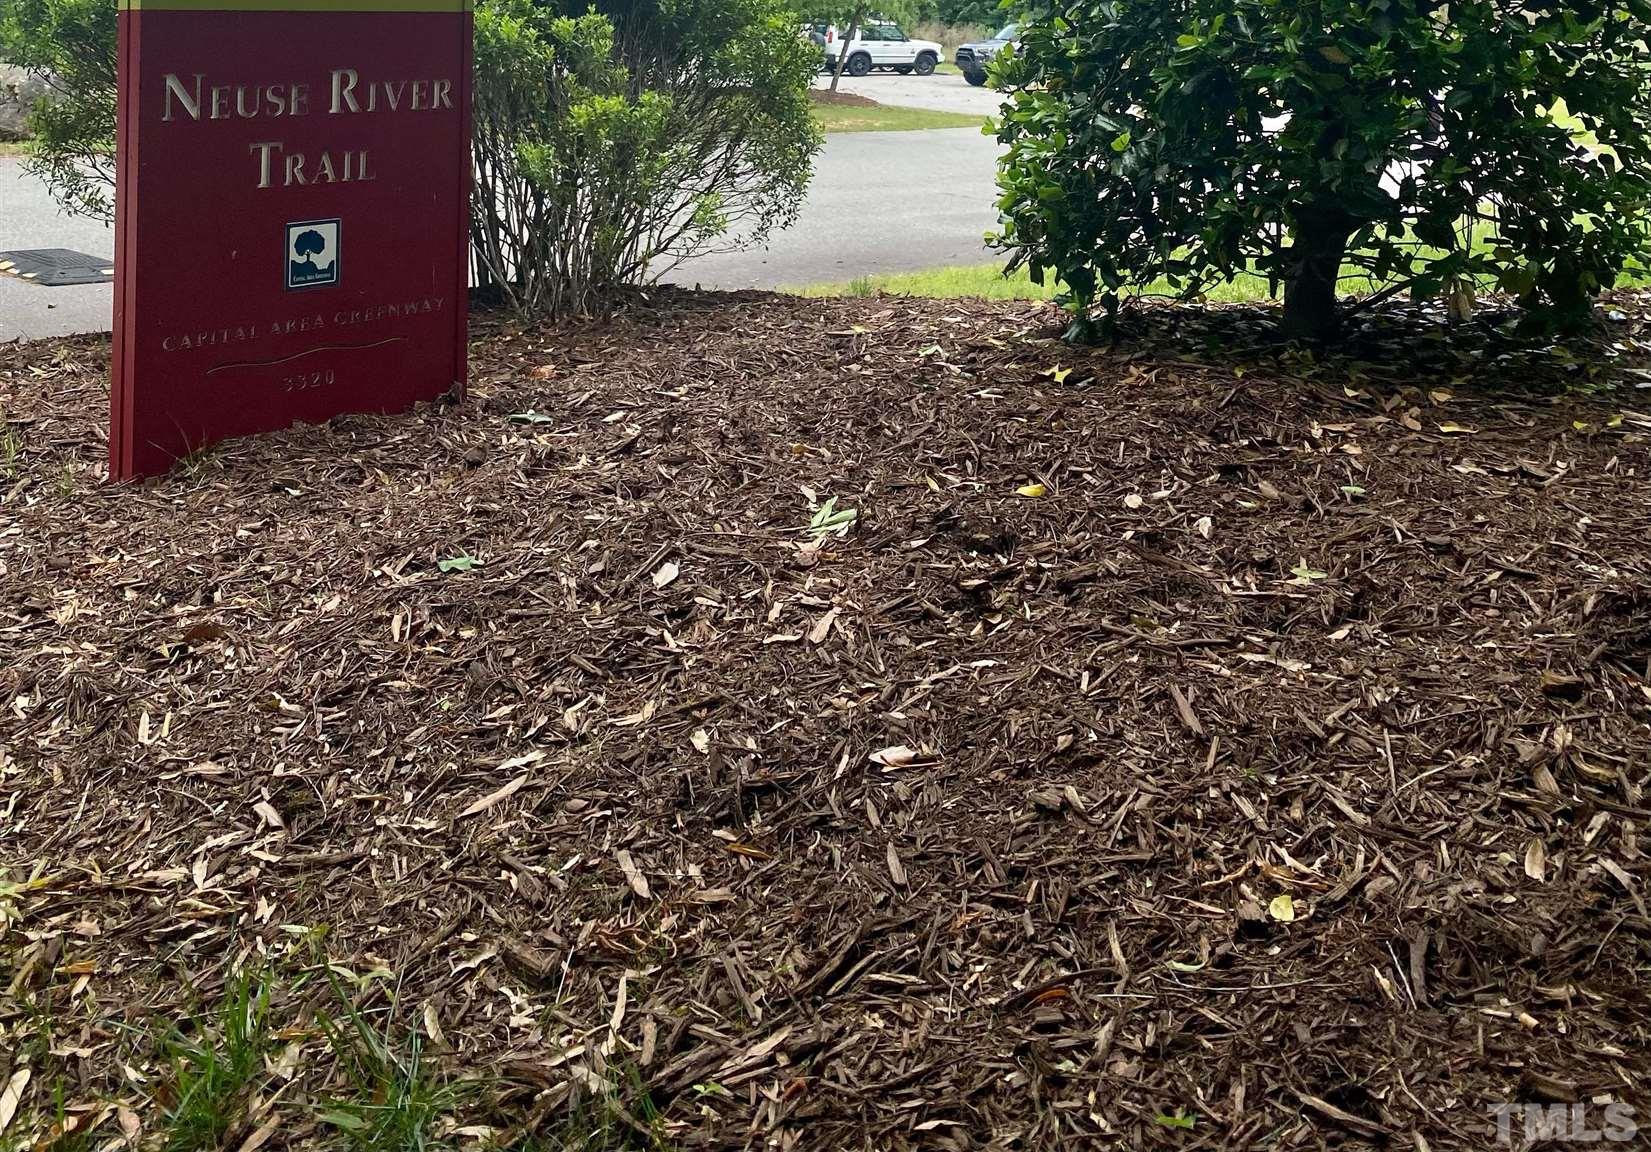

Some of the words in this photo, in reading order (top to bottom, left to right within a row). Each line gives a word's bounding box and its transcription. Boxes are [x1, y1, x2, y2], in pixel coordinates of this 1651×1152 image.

[250, 141, 377, 189] TRAIL
[162, 325, 258, 351] CAPITAL
[270, 314, 327, 336] AREA
[334, 297, 447, 325] GREENWAY
